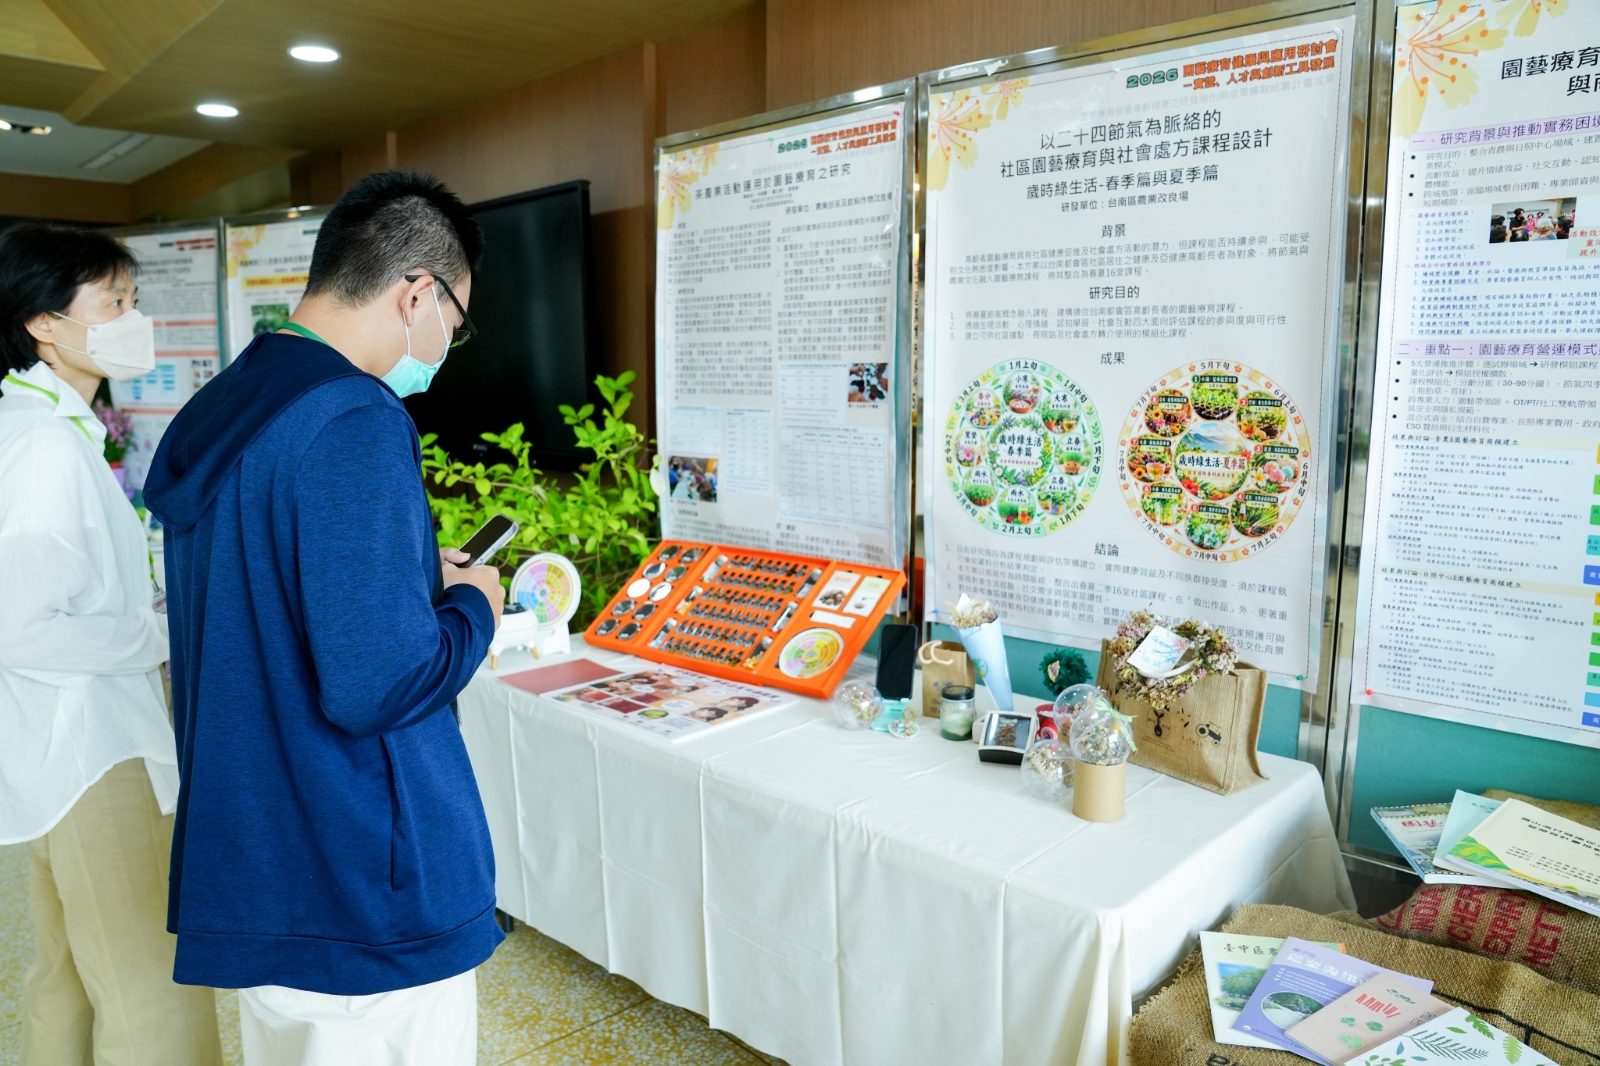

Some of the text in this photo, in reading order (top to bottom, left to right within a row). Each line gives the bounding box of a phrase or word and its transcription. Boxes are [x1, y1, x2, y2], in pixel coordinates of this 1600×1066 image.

[1126, 68, 1179, 88] 2026
[1566, 72, 1600, 97] 與
[1040, 109, 1222, 150] 以二十四節氣為脈絡的
[1000, 127, 1273, 178] 社區園藝療育與社會處方課程設計
[1026, 164, 1219, 200] 歲時綠生活-春季篇與夏季篇
[1101, 223, 1126, 238] 背景
[1089, 285, 1140, 300] 研究目的
[1398, 343, 1600, 356] 二、重點一：園藝療育營運模式
[1009, 361, 1038, 370] 1月上旬
[1100, 351, 1125, 366] 成果
[1200, 361, 1230, 371] 5月下旬
[1064, 380, 1088, 403] 1月中旬
[1274, 388, 1297, 414] 6月上旬
[1066, 436, 1081, 445] 立春
[1297, 462, 1309, 497] 6月中旬
[1002, 524, 1031, 535] 2月上旬
[1250, 531, 1277, 552] 7月上旬
[1094, 542, 1119, 557] 結論
[1194, 549, 1218, 561] 7月中旬
